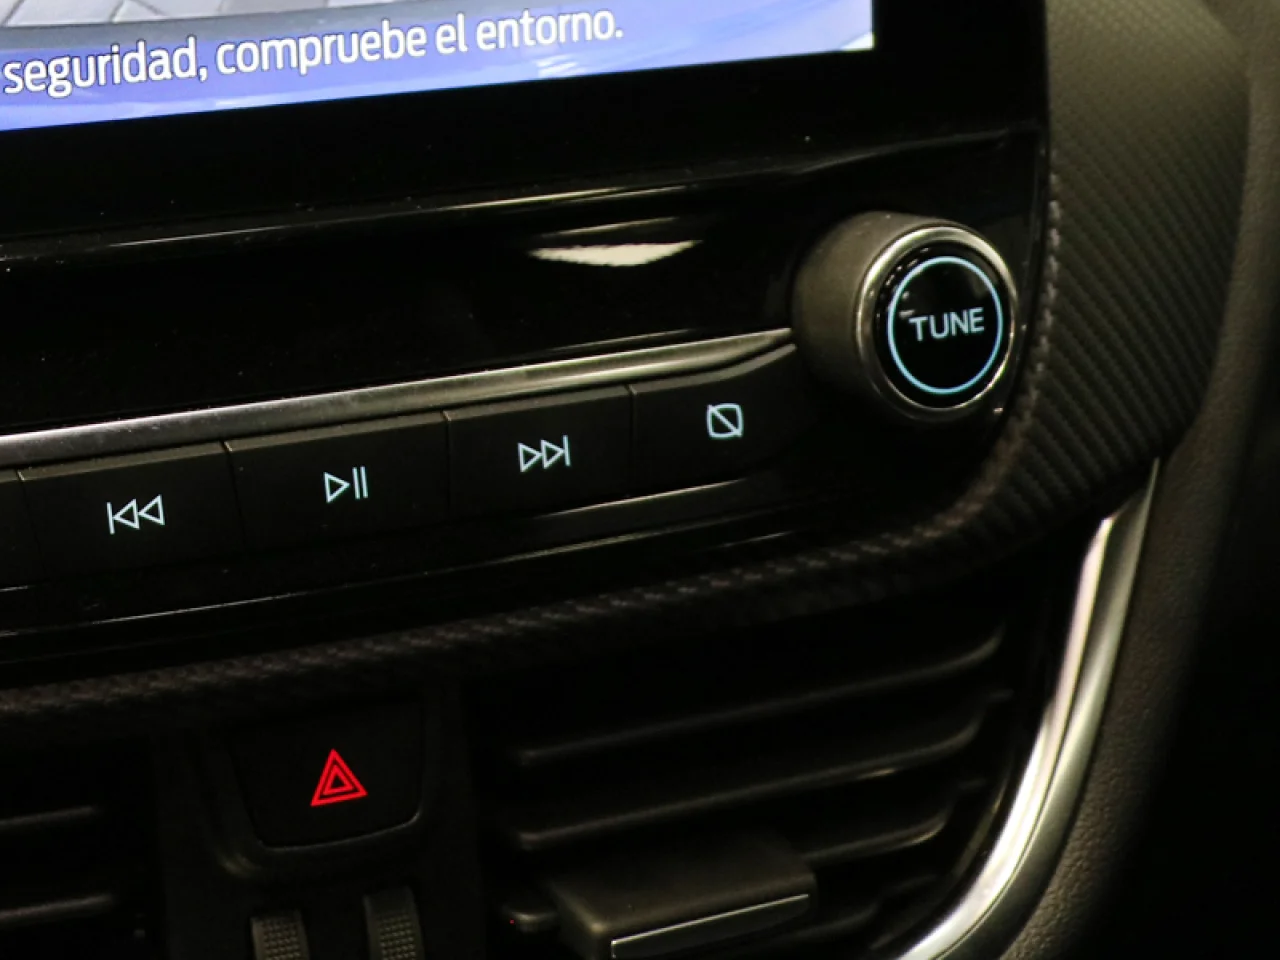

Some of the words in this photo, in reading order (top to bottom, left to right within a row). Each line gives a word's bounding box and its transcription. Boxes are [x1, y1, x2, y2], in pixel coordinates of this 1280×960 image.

[3, 34, 208, 99] seguridad,
[216, 18, 428, 74] compruebe
[435, 13, 469, 54] el
[476, 8, 624, 51] entorno.
[908, 307, 985, 341] TUNE
